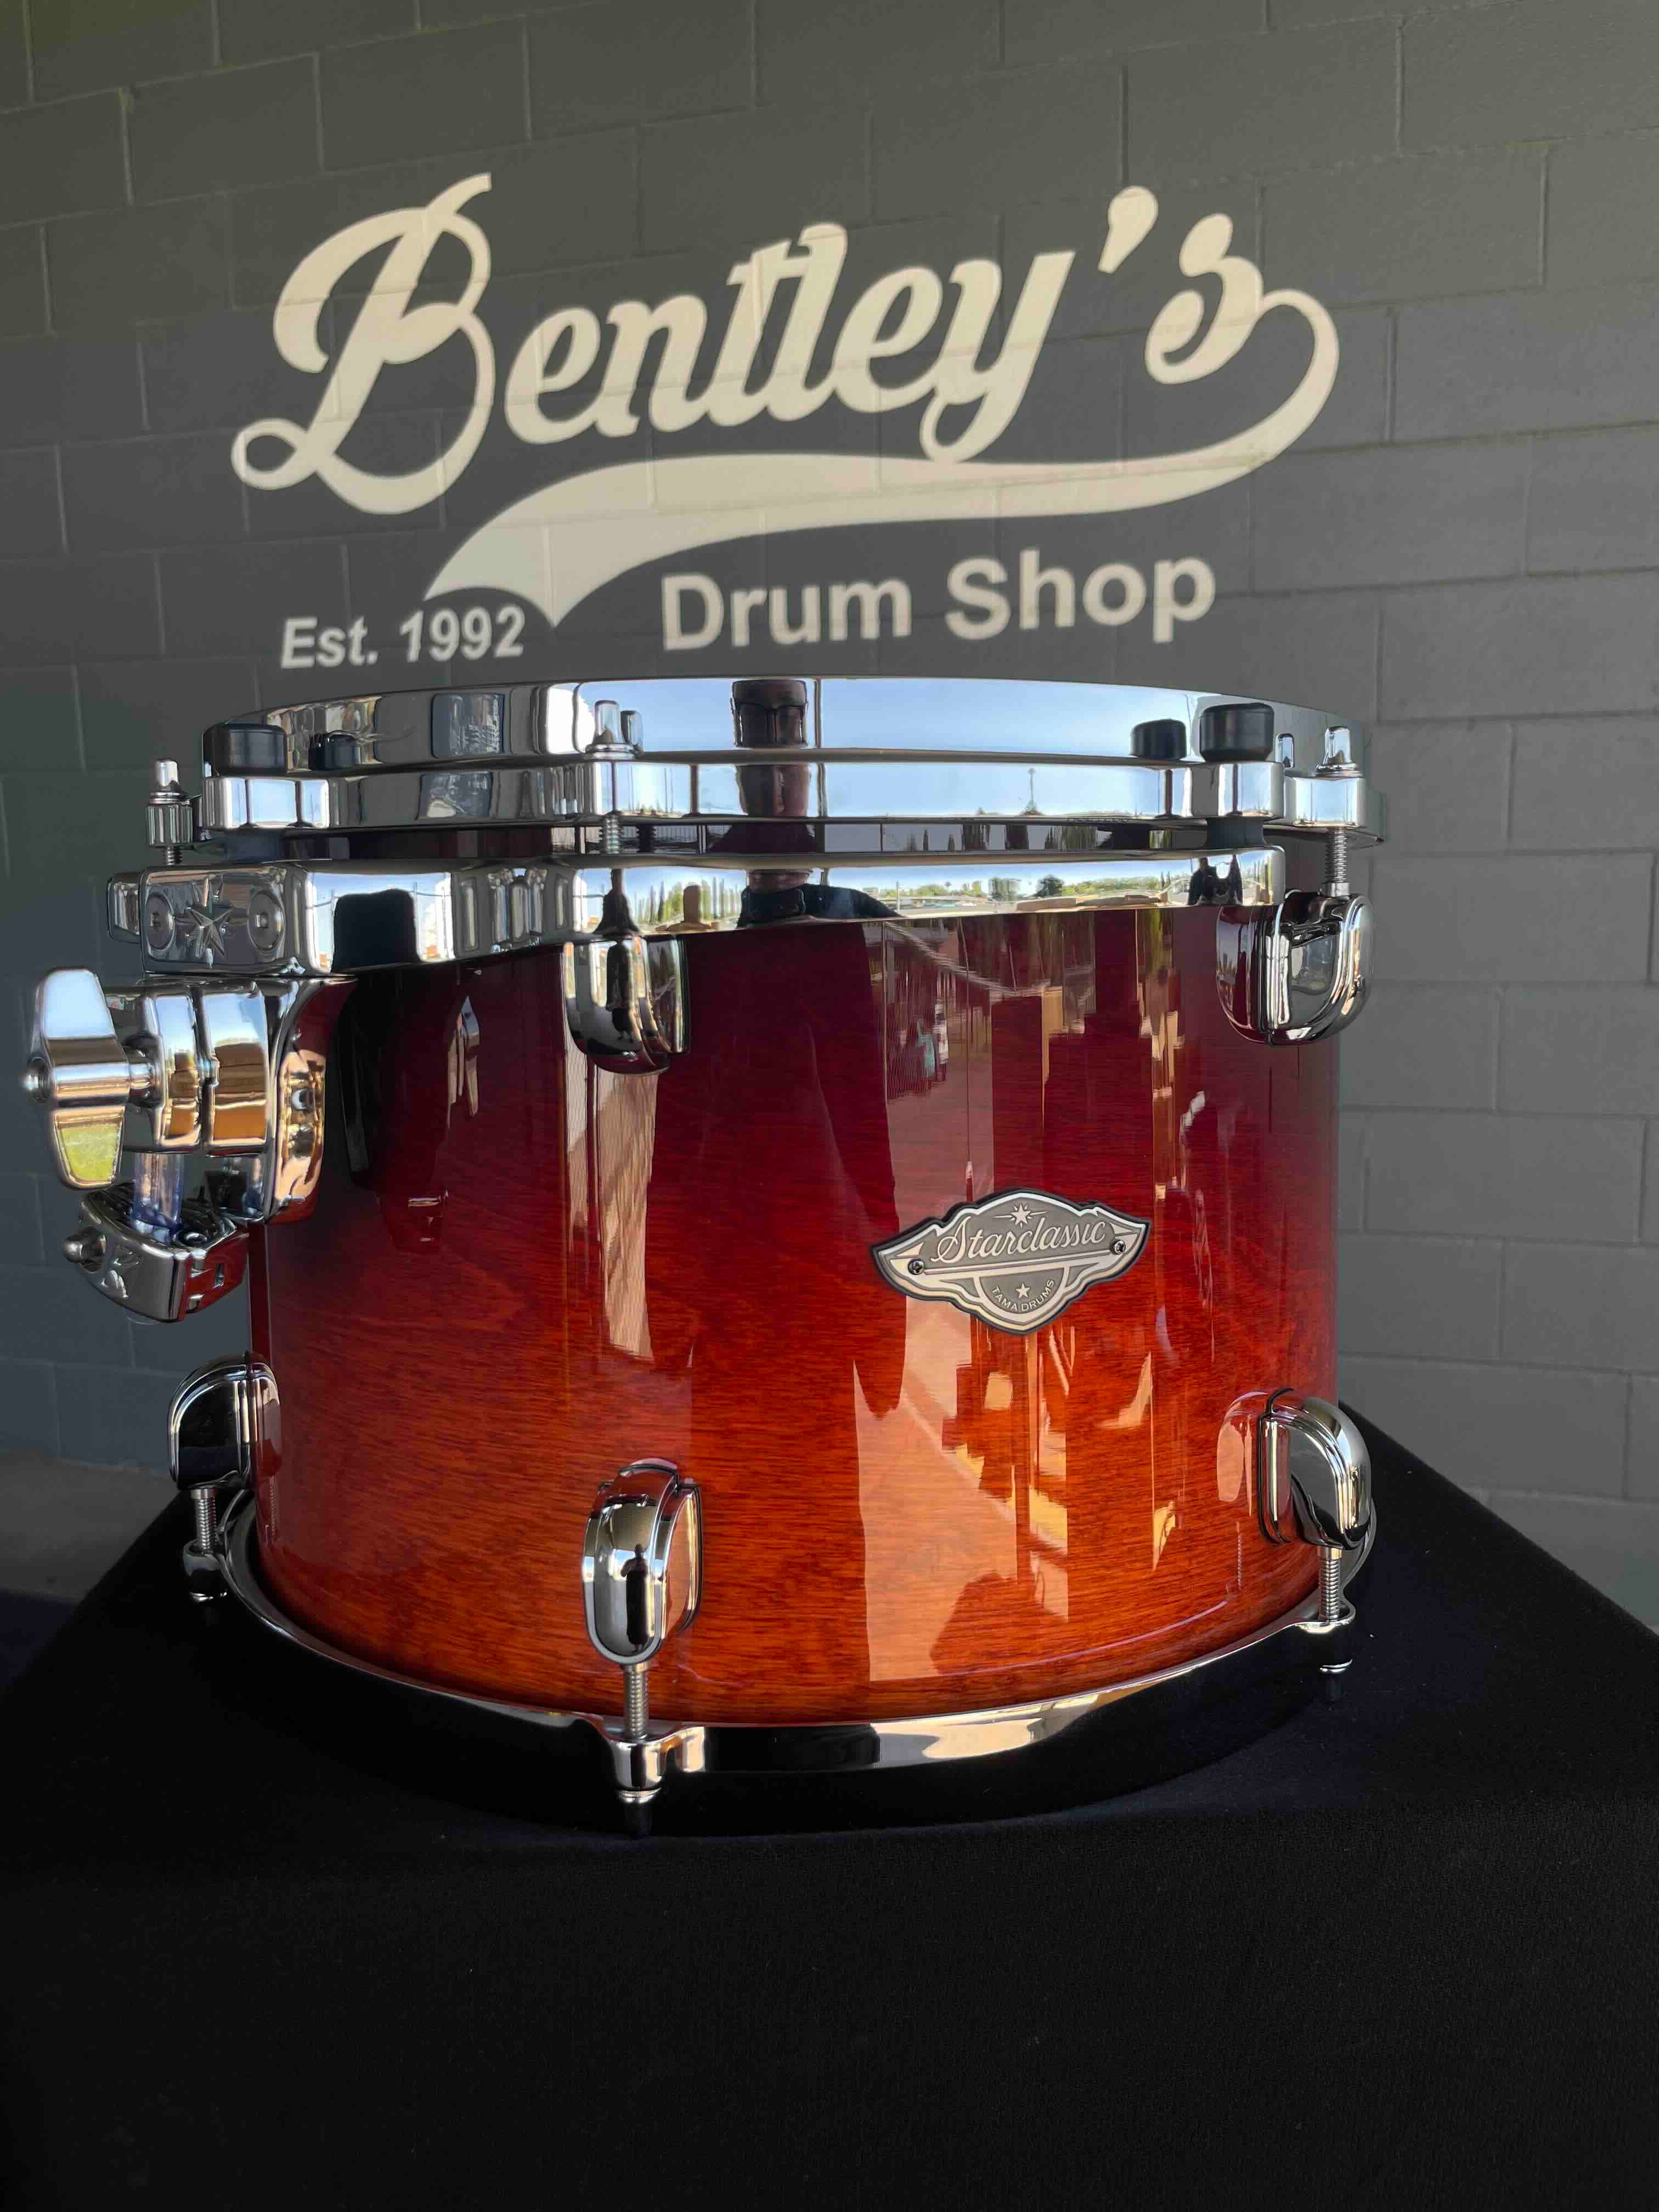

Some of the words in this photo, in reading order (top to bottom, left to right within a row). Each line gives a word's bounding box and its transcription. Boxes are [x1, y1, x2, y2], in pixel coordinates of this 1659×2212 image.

[231, 172, 1339, 515] Bentley's
[661, 571, 912, 651] Drum
[945, 547, 1216, 644] Shop
[280, 616, 379, 669] Est.
[399, 604, 526, 662] 1992
[930, 1215, 1107, 1263] Starclassic
[992, 1285, 1018, 1311] TAMA
[1021, 1279, 1054, 1312] DRUMS
